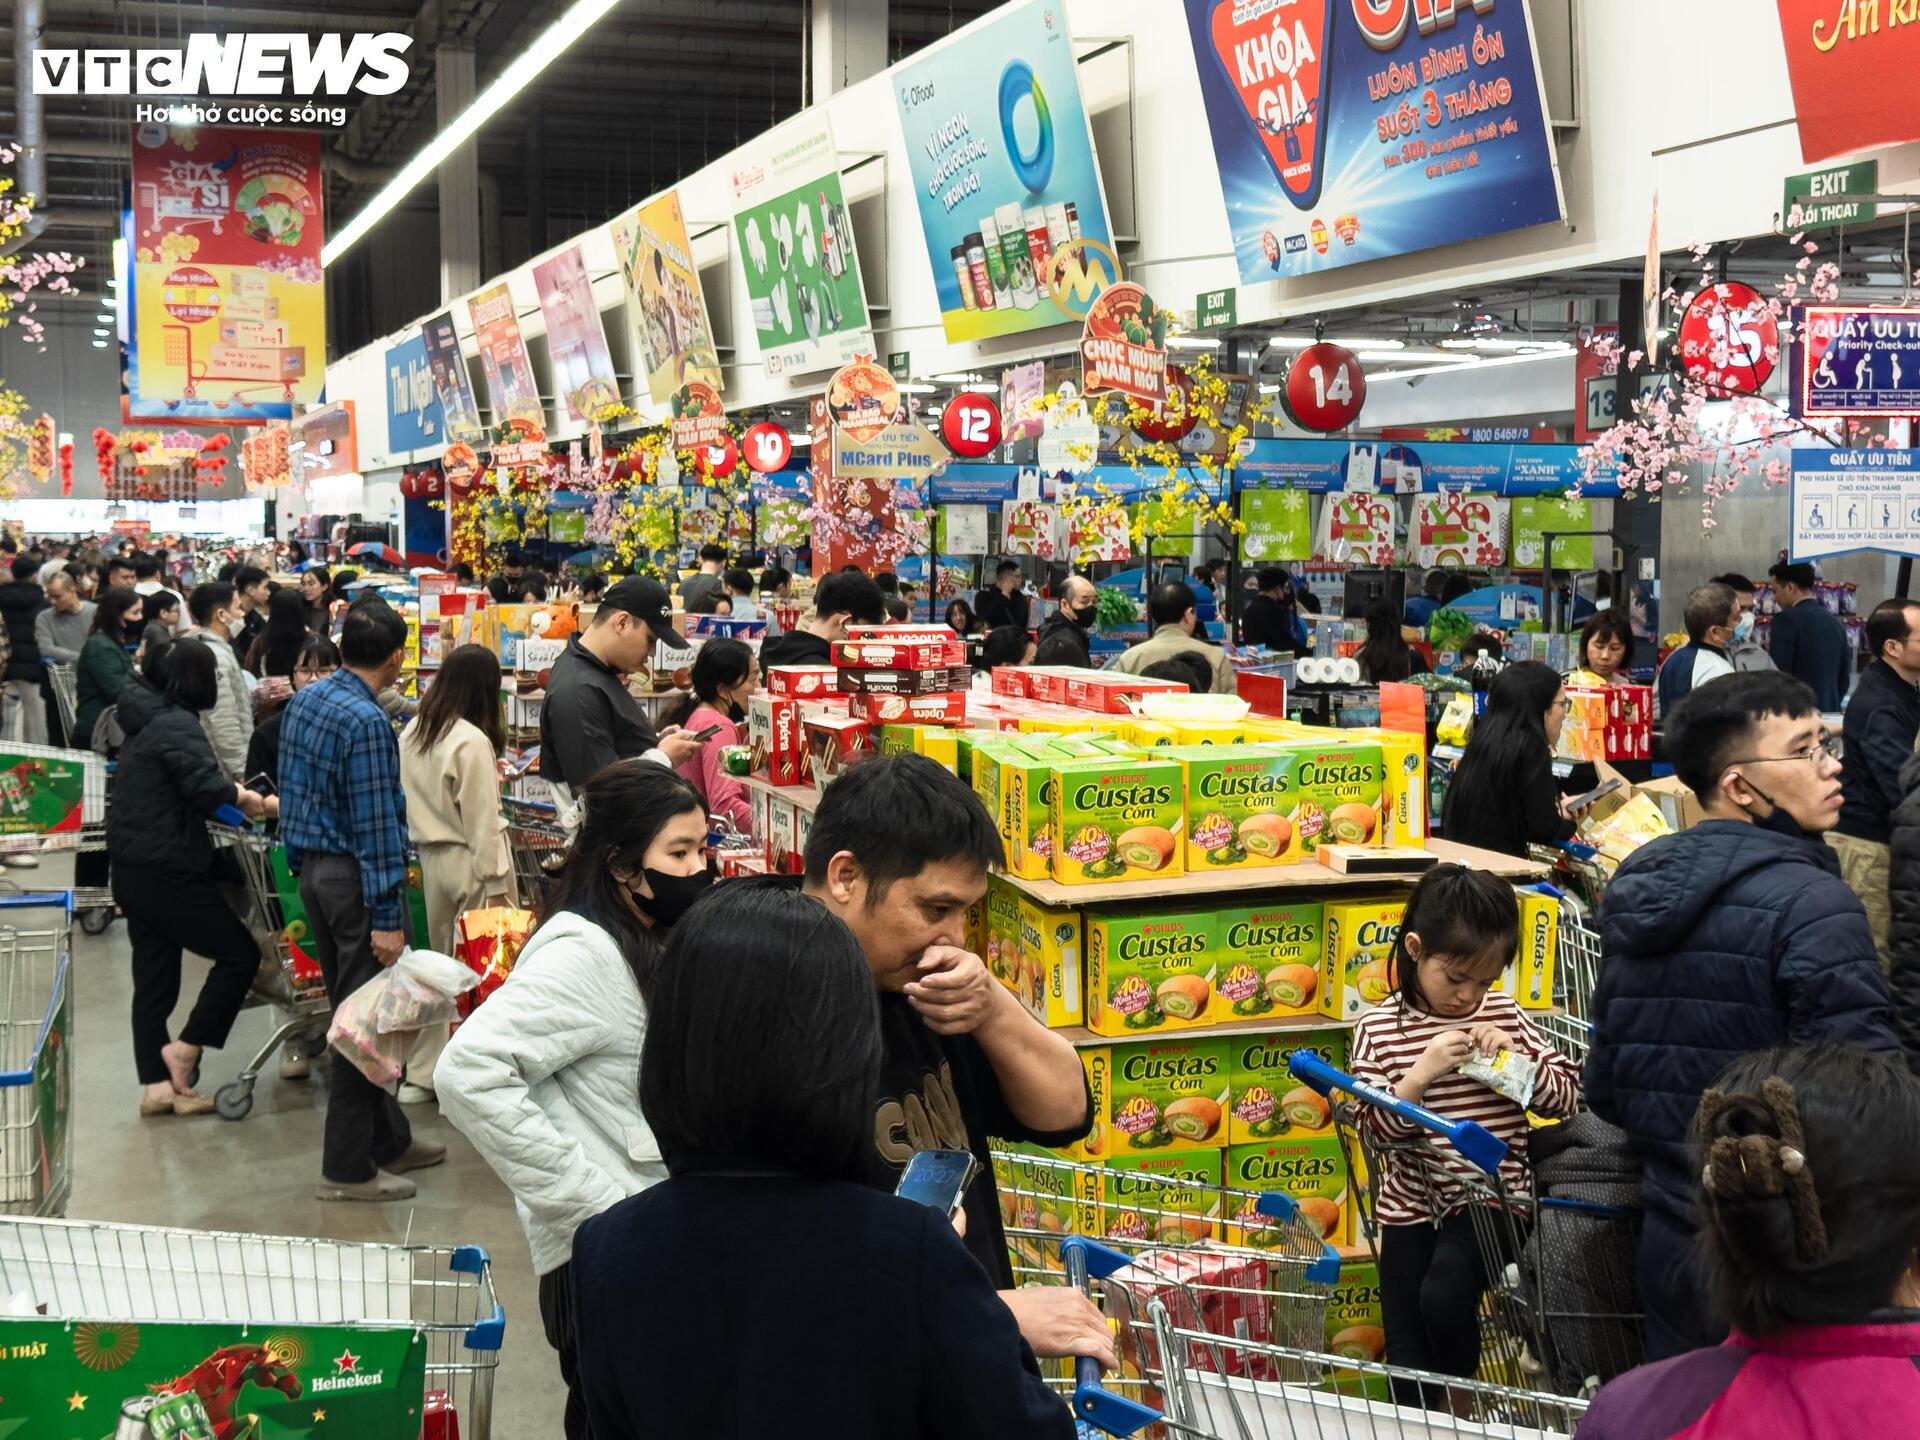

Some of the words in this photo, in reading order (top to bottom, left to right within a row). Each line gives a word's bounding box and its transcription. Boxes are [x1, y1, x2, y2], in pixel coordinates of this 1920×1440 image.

[1234, 14, 1316, 87] KHÓA
[1367, 62, 1417, 101] LUÔN
[1420, 44, 1469, 83] BÌNH
[1472, 24, 1505, 65] ỔN
[1257, 65, 1313, 136] GIÁ
[1376, 98, 1420, 141] SUỐT
[1422, 88, 1441, 127] 3
[1444, 77, 1512, 120] THÁNG
[925, 131, 940, 163] VỊ
[938, 112, 969, 151] NGON
[929, 172, 945, 198] CHO
[944, 148, 965, 182] CUỘC
[962, 137, 988, 165] SỐNG
[1810, 170, 1850, 197] EXIT
[1207, 292, 1225, 309] EXIT
[1707, 310, 1764, 368] 15
[1838, 341, 1873, 351] Priority
[1084, 338, 1125, 362] CHÚC
[1128, 346, 1164, 374] MỪNG
[1095, 360, 1131, 384] NĂM
[1134, 370, 1158, 392] MỚI
[1308, 364, 1350, 406] 14
[1589, 386, 1616, 417] 13
[958, 406, 991, 443] 12
[1471, 429, 1492, 442] 1800
[754, 431, 783, 462] 10
[841, 451, 893, 466] MCard
[897, 451, 932, 467] Plus
[1829, 449, 1864, 465] QUẦY
[1868, 451, 1884, 465] ƯU
[1888, 450, 1912, 466] TIÊN
[427, 477, 438, 490] 2
[1250, 521, 1271, 533] Shop
[776, 708, 792, 751] Opéra
[912, 709, 945, 721] Opéra
[1200, 773, 1289, 799] Custas
[1299, 762, 1373, 787] Custas
[1074, 784, 1171, 811] Custas
[1399, 792, 1407, 824] Custas
[1119, 932, 1207, 961] Custas
[1228, 923, 1315, 949] Custas
[1327, 917, 1338, 982] Custas
[1534, 911, 1549, 969] Custas
[1052, 963, 1061, 998] Custas
[1123, 1055, 1218, 1083] Custas
[1152, 1158, 1184, 1168] ORION
[1240, 1154, 1336, 1181] Custas
[1024, 1160, 1064, 1197] Custas
[1113, 1167, 1209, 1196] Custas
[1084, 1172, 1098, 1232] Custas
[11, 1341, 48, 1359] THẬT
[312, 1369, 383, 1392] Heineken
